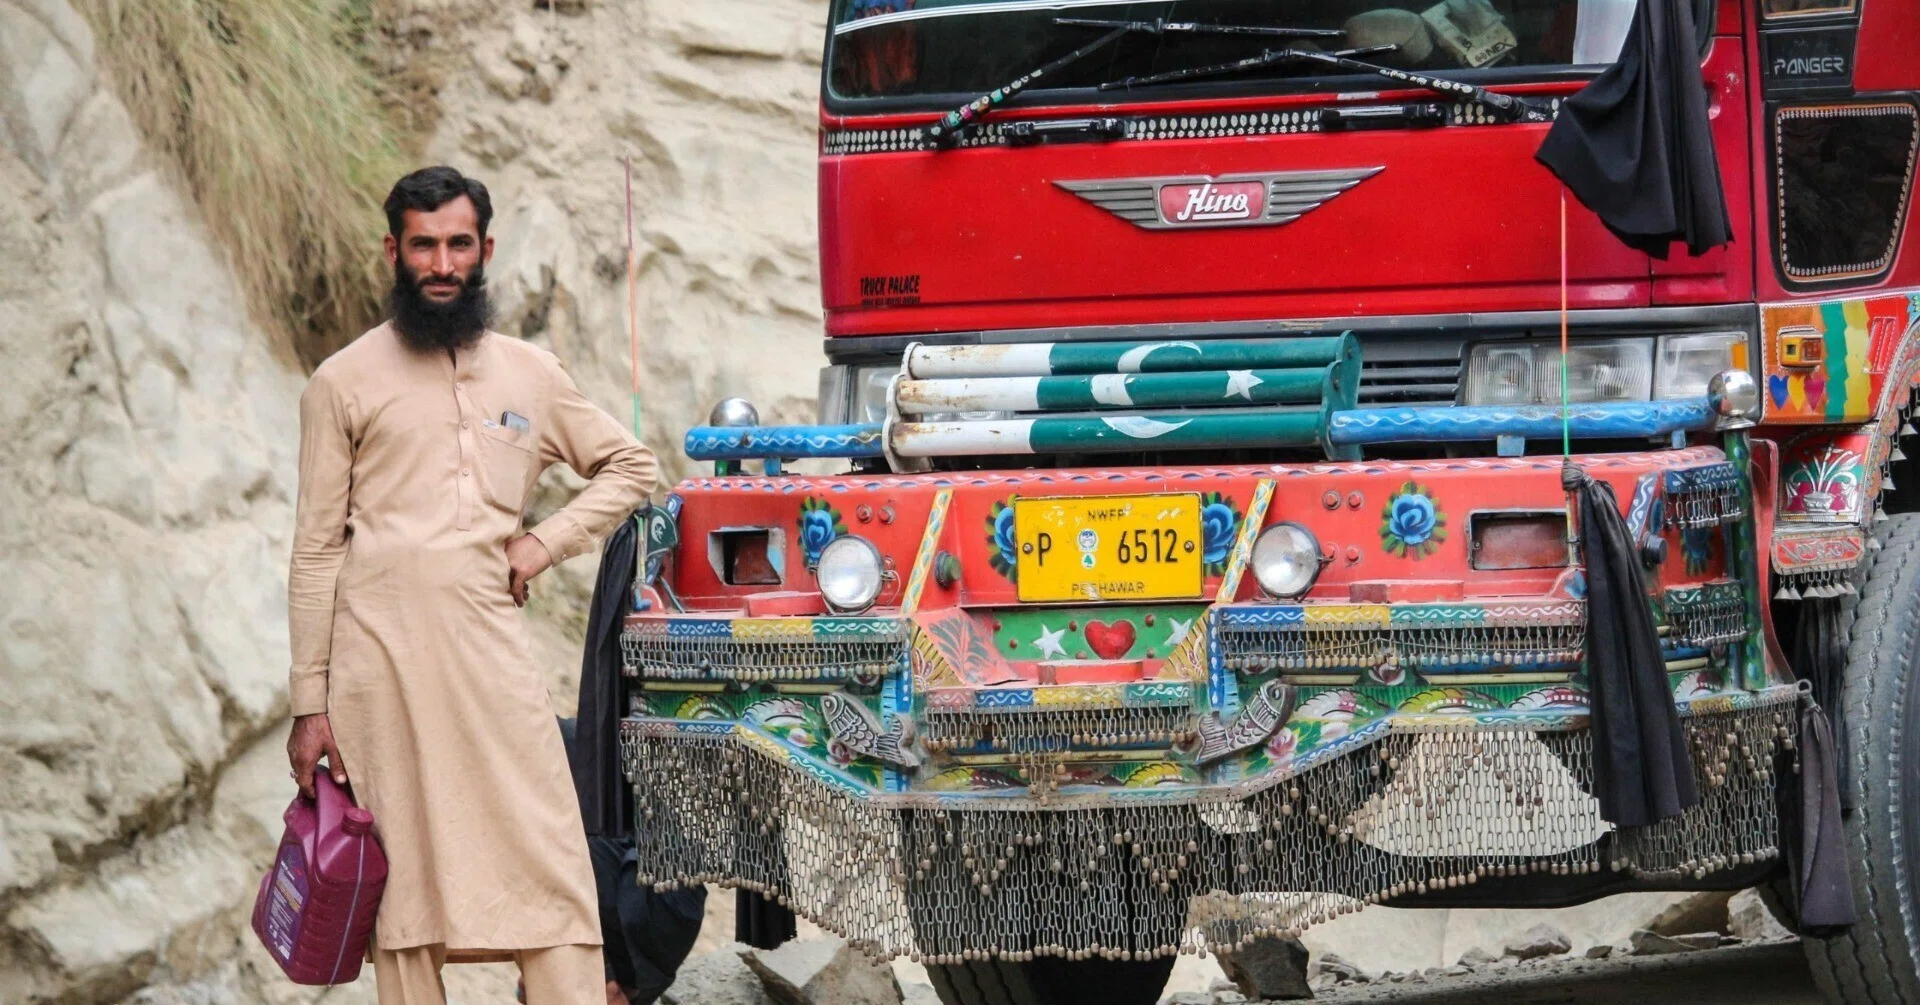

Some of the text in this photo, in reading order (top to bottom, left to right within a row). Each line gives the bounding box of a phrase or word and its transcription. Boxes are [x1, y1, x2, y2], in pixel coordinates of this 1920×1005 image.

[1177, 183, 1250, 221] Hino
[860, 275, 920, 296] TRUCK PALACE
[1087, 508, 1125, 522] NWFP
[1037, 528, 1178, 567] P 6512
